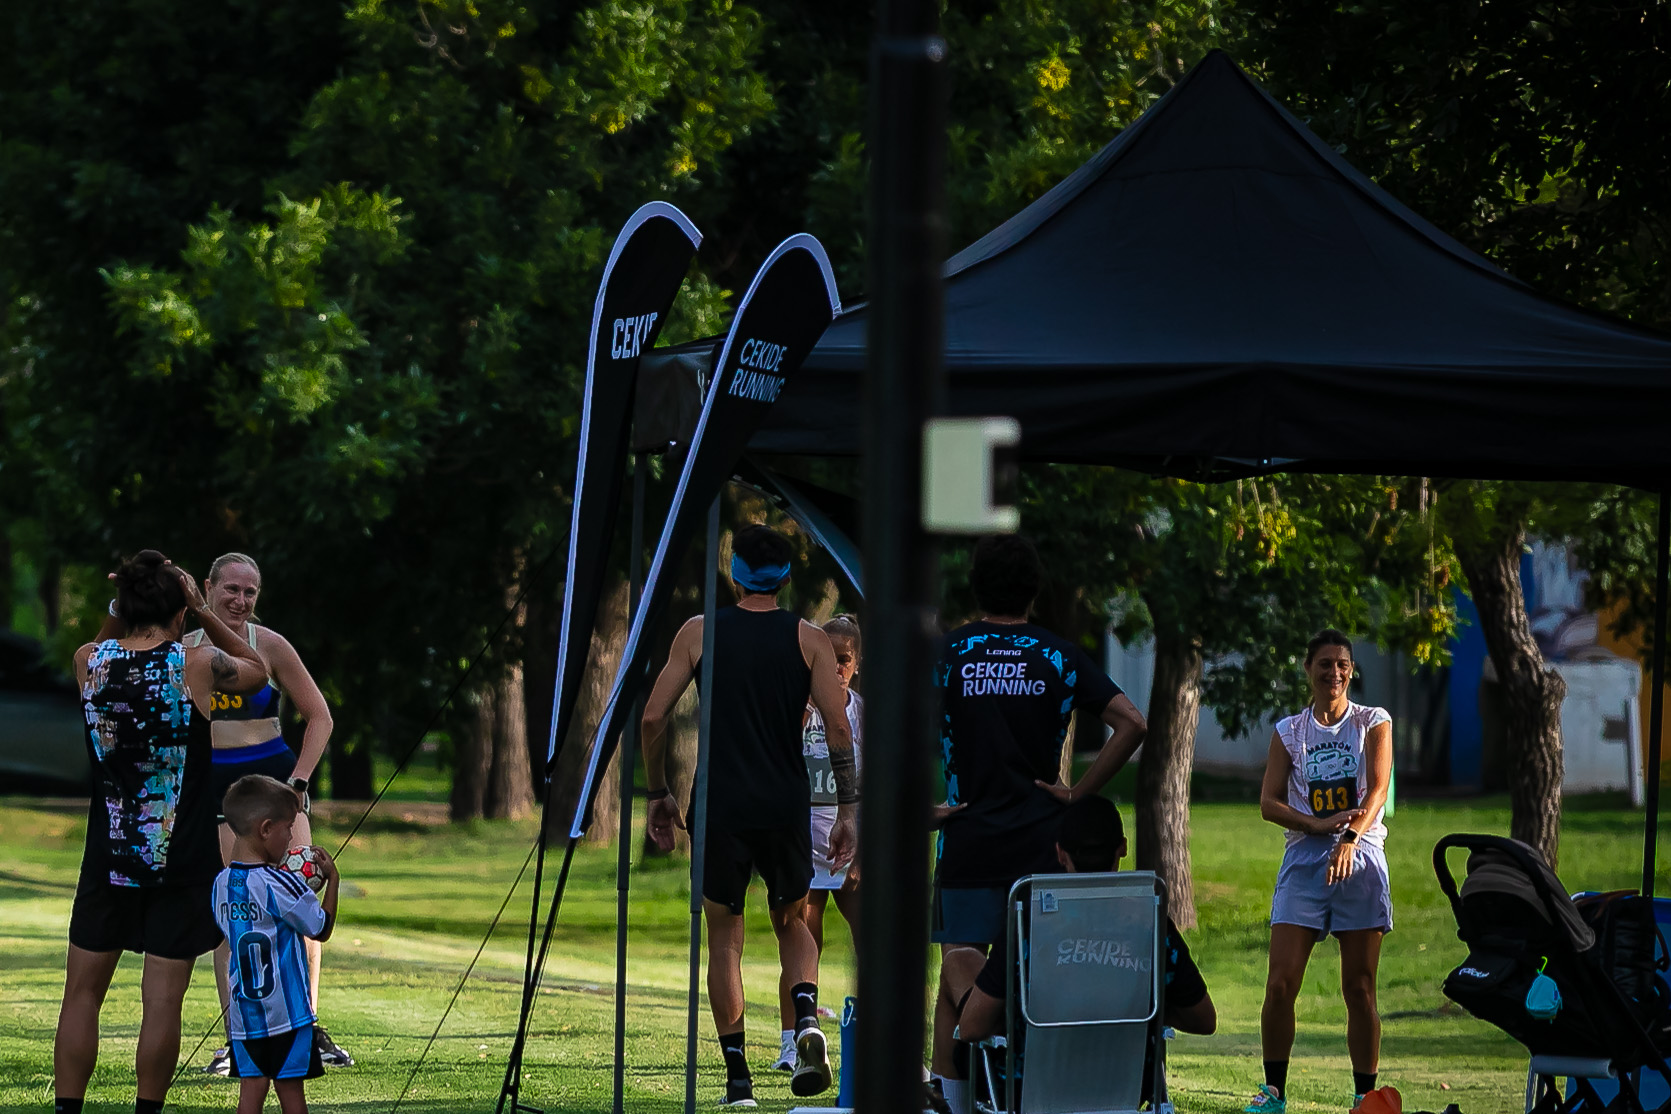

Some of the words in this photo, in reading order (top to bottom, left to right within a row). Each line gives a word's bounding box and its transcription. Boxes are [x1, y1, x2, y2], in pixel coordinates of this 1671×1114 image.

[740, 337, 788, 372] CEKIDE
[961, 661, 1028, 679] CEKIDE
[962, 678, 1046, 697] RUNNING
[1313, 786, 1348, 812] 613
